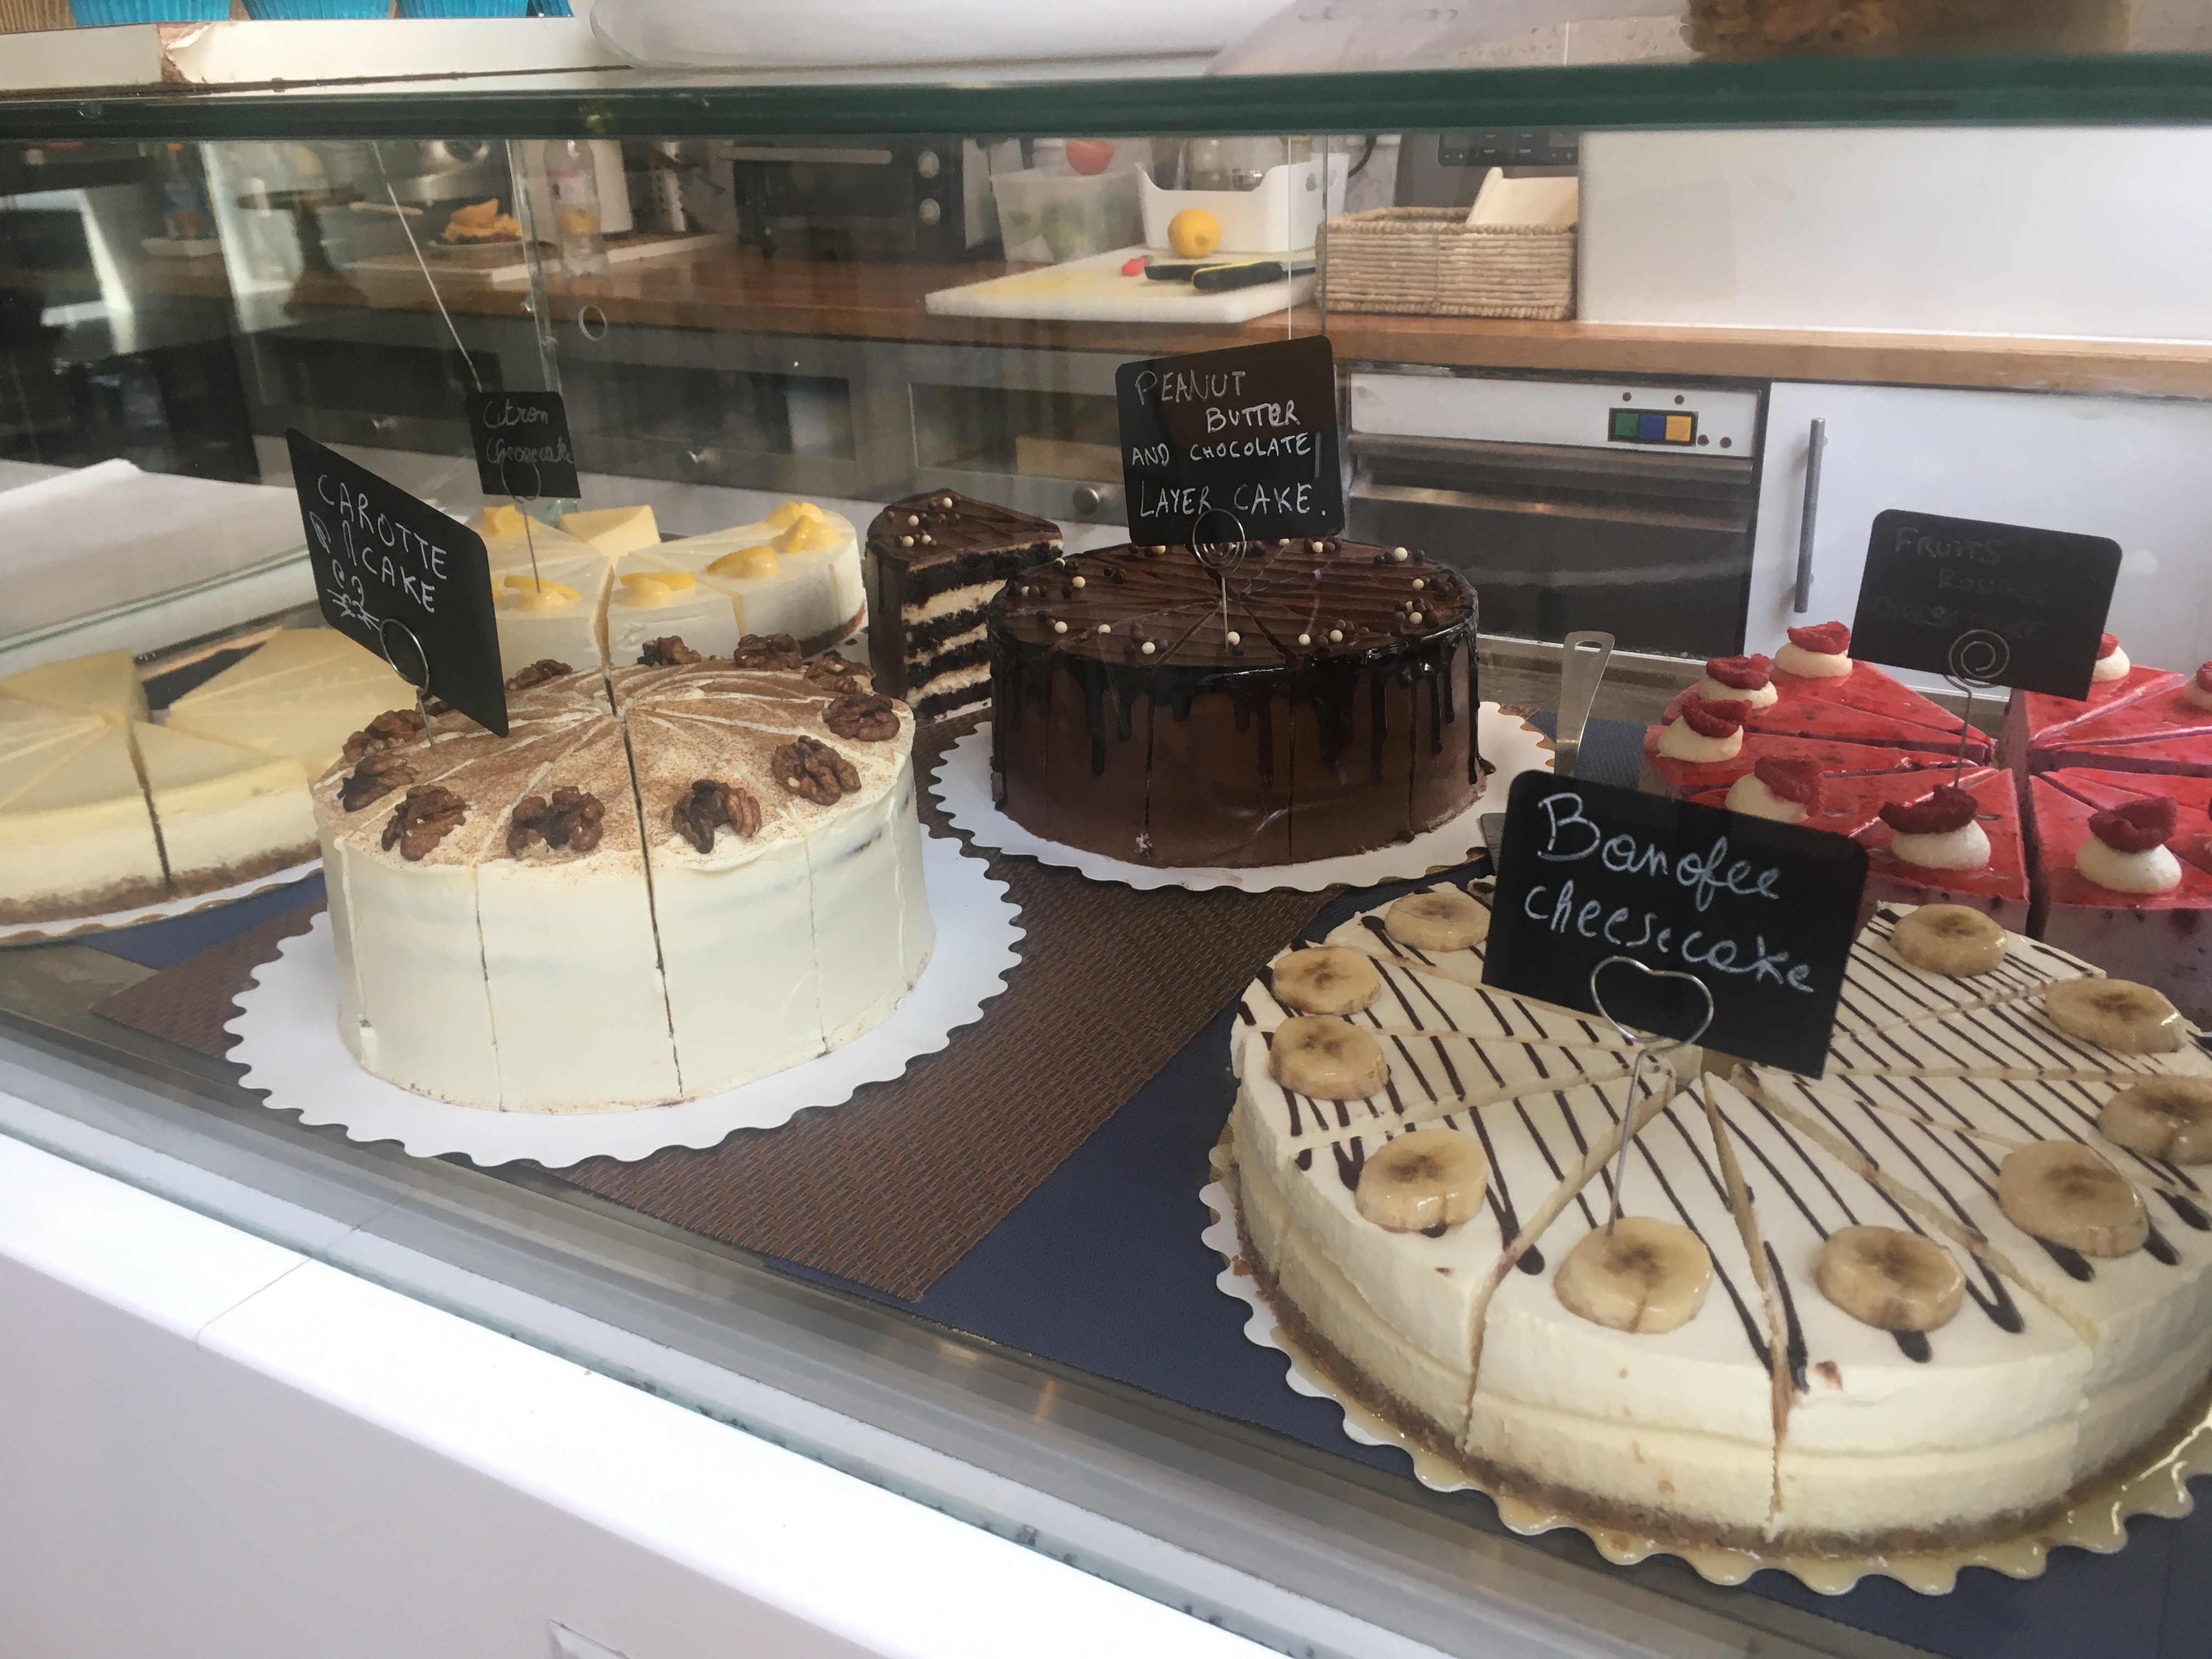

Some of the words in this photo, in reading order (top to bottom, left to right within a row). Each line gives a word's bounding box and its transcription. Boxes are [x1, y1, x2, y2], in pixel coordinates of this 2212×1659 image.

[1134, 369, 1246, 406] PEANUT
[1206, 399, 1300, 433] BUTTER
[1131, 443, 1170, 466] AND
[1189, 432, 1311, 461] CHOCOLATE
[1139, 480, 1211, 518] LAYER
[318, 474, 447, 580] CAROTTE
[362, 546, 435, 613] CAKE
[1537, 793, 1780, 912] Banofee
